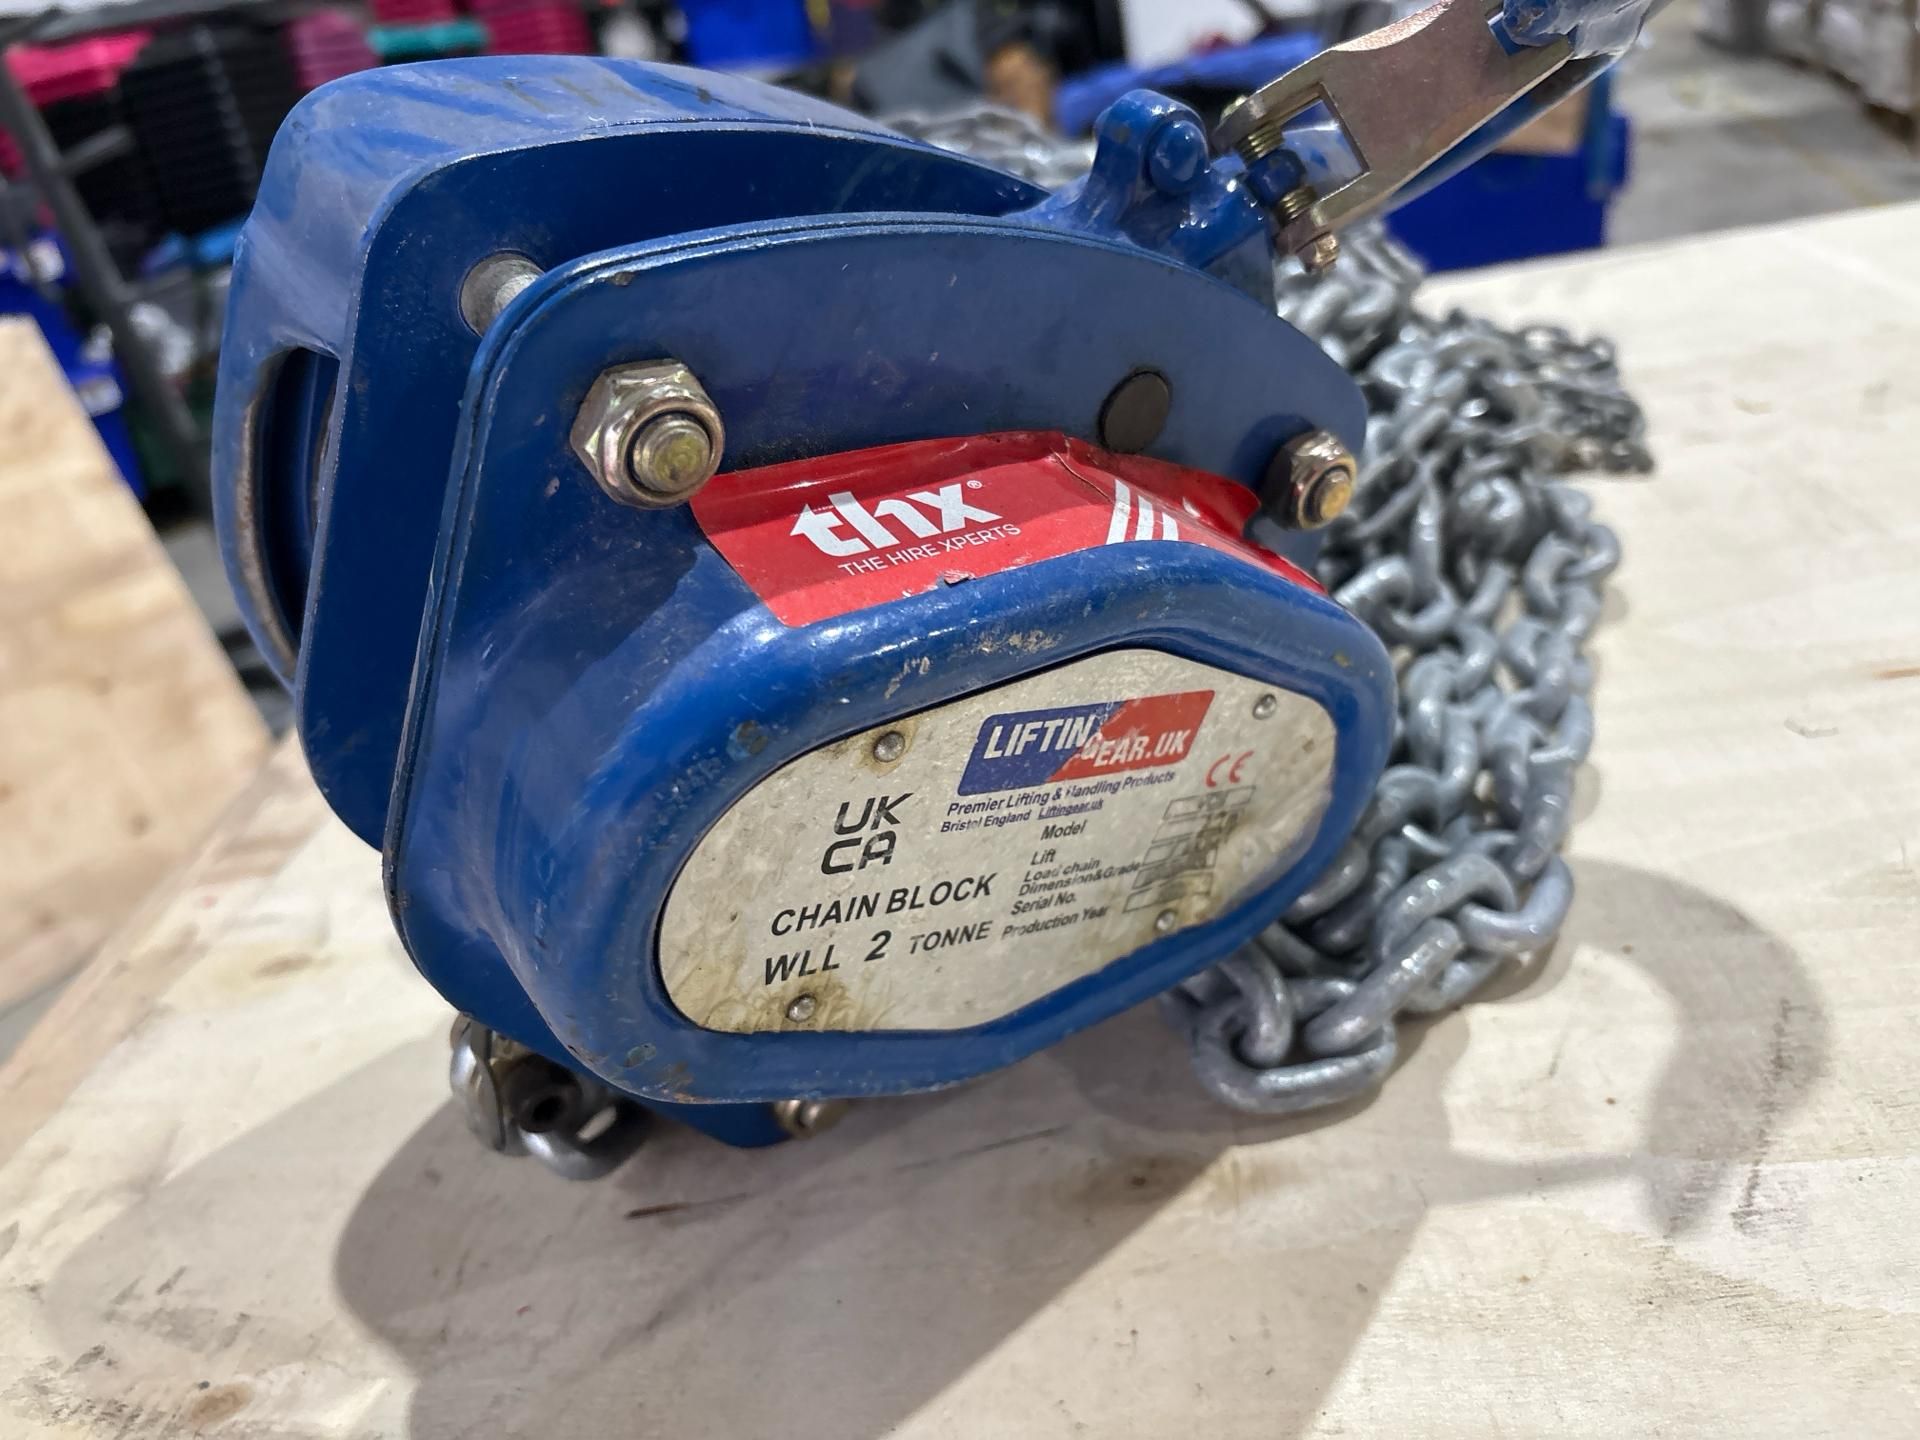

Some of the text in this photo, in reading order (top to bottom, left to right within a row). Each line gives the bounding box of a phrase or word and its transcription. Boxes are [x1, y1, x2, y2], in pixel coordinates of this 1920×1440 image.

[837, 523, 1022, 576] THE HIRE XPERTS
[1205, 751, 1255, 788] CE
[947, 798, 1005, 816] Premier
[1006, 792, 1050, 808] Lifting
[1052, 788, 1062, 801] &
[1122, 771, 1175, 790] Products
[834, 792, 914, 835] UK
[940, 817, 983, 833] Bristol
[984, 809, 1032, 827] England
[1040, 819, 1088, 840] Model
[820, 830, 897, 875] CA
[1030, 848, 1056, 866] Lift
[1062, 857, 1101, 875] chain
[771, 872, 998, 936] CHAIN BLOCK
[1011, 891, 1077, 915] Serial No.
[1001, 905, 1110, 940] Production Year
[764, 920, 993, 985] WLL 2 TONNE
